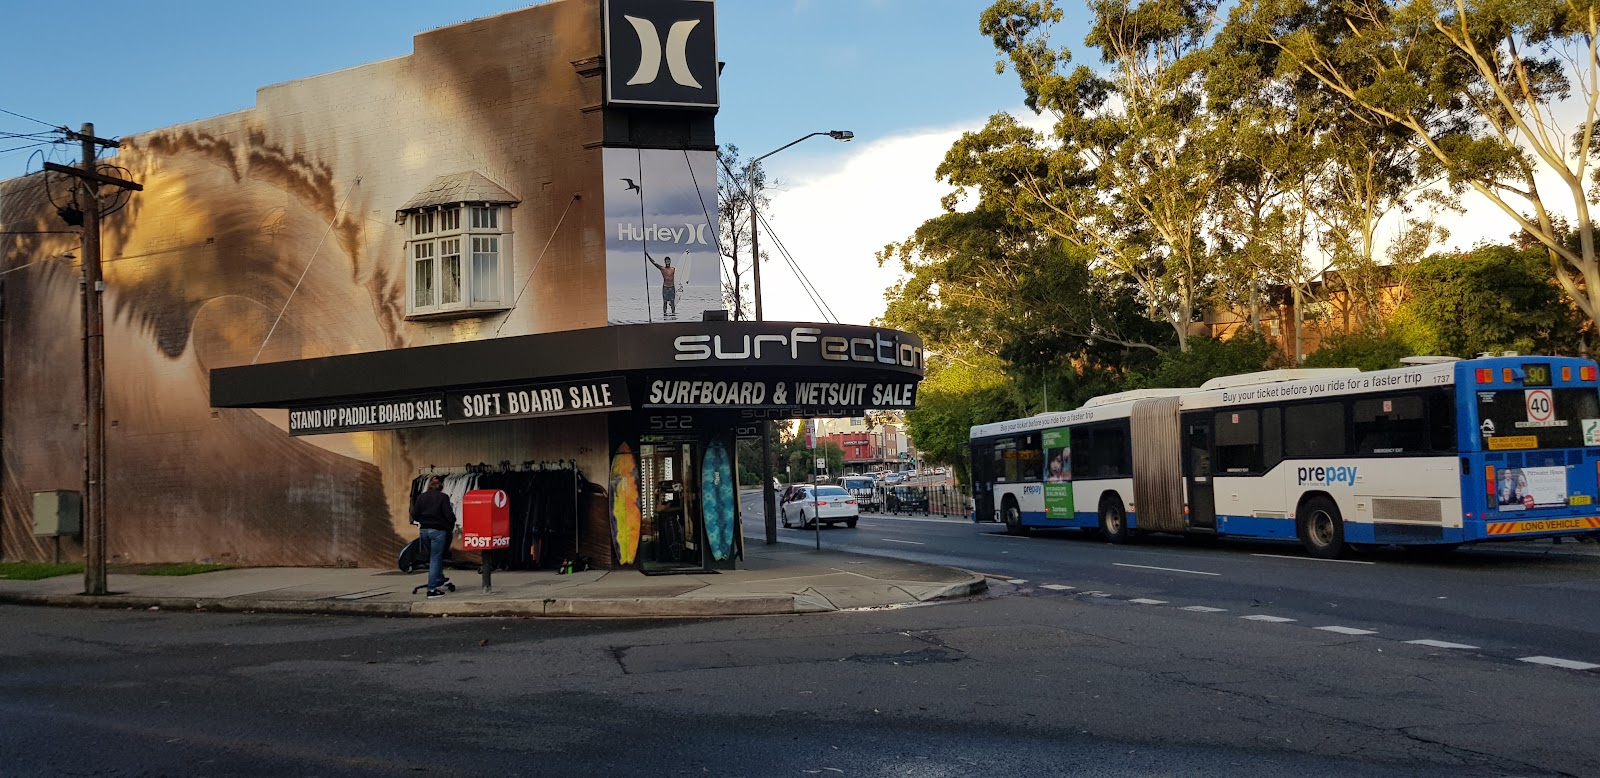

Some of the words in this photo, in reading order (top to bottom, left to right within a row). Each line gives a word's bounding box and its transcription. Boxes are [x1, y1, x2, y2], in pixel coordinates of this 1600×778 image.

[618, 223, 685, 244] Hurley
[673, 327, 923, 369] surfection
[1222, 392, 1237, 403] Buy
[1238, 392, 1255, 401] your
[1256, 386, 1279, 398] ticket
[1280, 385, 1307, 396] before
[1309, 384, 1326, 394] you
[1327, 380, 1345, 391] ride
[1347, 379, 1360, 389] for
[1363, 380, 1369, 388] a
[1372, 376, 1401, 387] faster
[1404, 372, 1422, 384] trip
[1433, 375, 1450, 383] 1737
[463, 393, 501, 418] SOFT
[507, 388, 564, 414] BOARD
[569, 384, 613, 409] SALE
[649, 380, 766, 405] SURFBOARD
[773, 382, 788, 405] &
[795, 382, 867, 406] WETSUIT
[872, 384, 913, 406] SALE
[290, 410, 321, 430] STAND
[322, 408, 337, 428] UP
[338, 406, 377, 426] PADDLE
[378, 402, 414, 423] BOARD
[416, 400, 442, 420] SALE
[1531, 398, 1549, 413] 40
[1000, 424, 1008, 432] Buy
[1008, 423, 1016, 432] your
[1042, 419, 1050, 427] you
[1085, 412, 1094, 420] trip
[1298, 466, 1358, 486] prepay
[1024, 485, 1042, 495] prepay
[1521, 522, 1544, 531] LONG
[1545, 520, 1580, 529] VEHICLE
[464, 536, 491, 547] POST
[492, 536, 510, 546] POST
